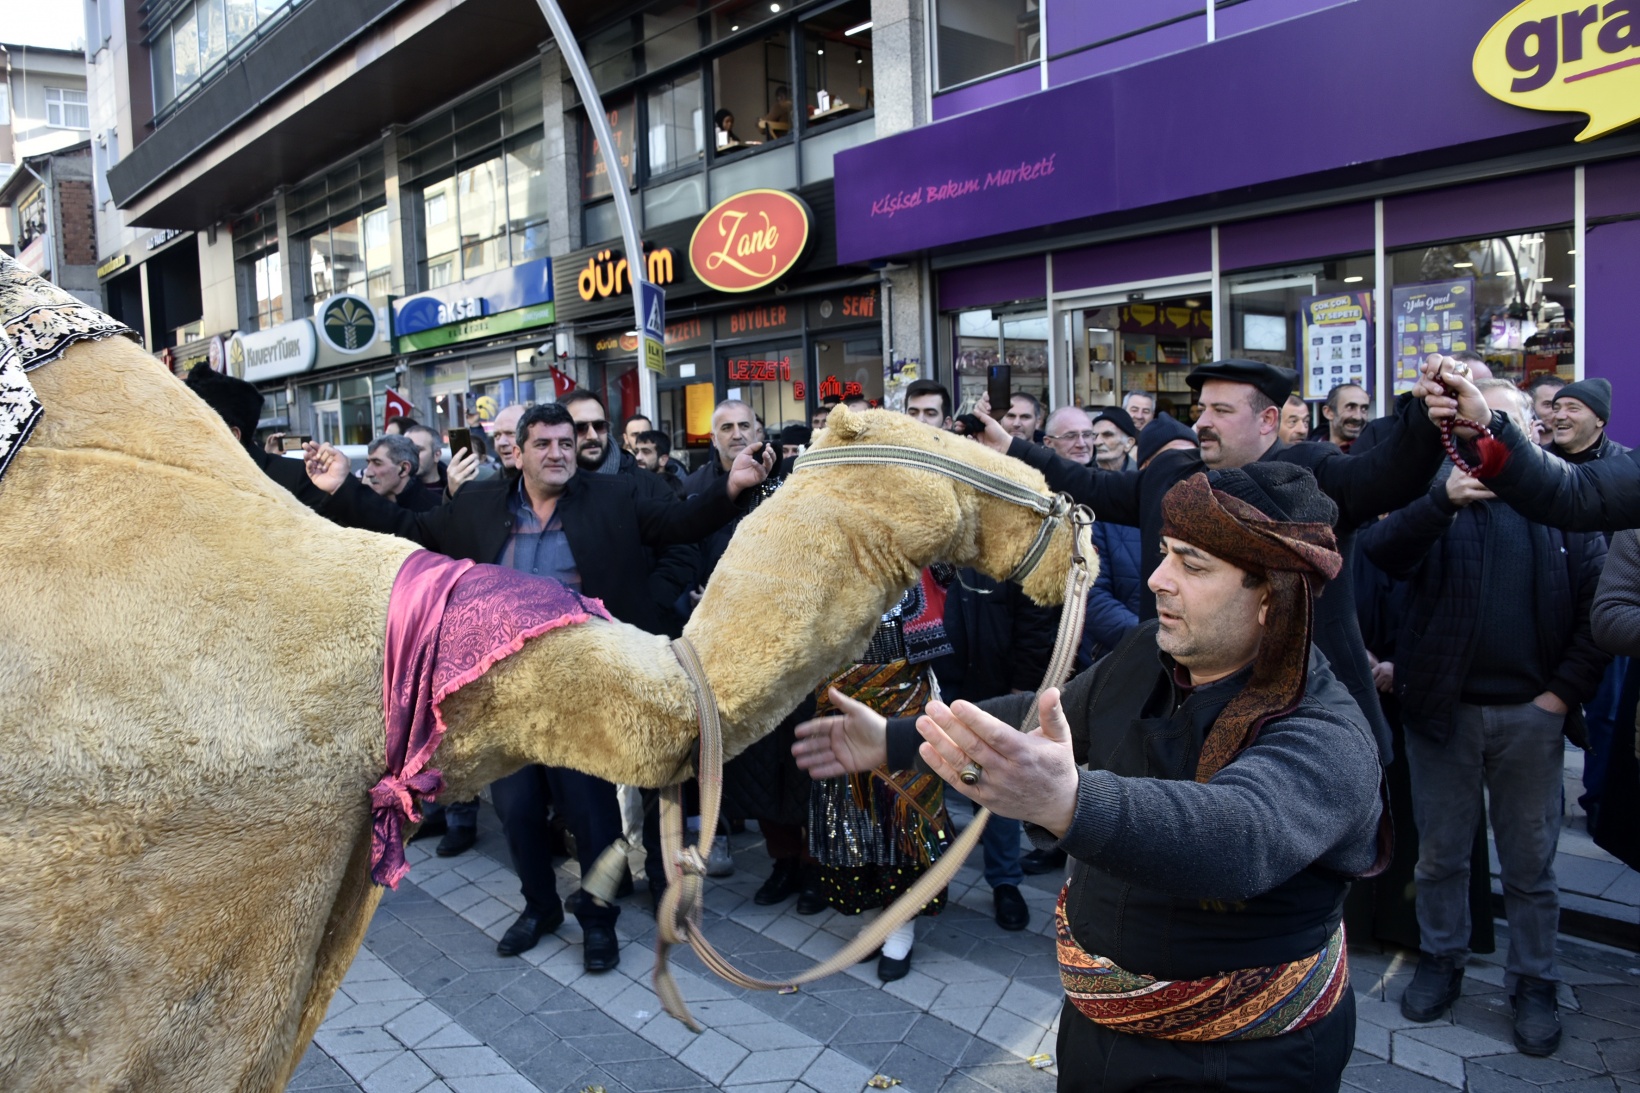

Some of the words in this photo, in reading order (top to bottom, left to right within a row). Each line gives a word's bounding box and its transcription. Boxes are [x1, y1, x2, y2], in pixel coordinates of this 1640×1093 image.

[871, 187, 922, 218] Kişisel
[926, 176, 980, 204] Bakım
[983, 153, 1056, 191] Marketi
[706, 210, 779, 278] Zane
[578, 248, 673, 301] dürm
[438, 297, 476, 325] aksa
[730, 305, 787, 333] BÜYÜLER
[1315, 313, 1326, 321] AT
[1327, 309, 1360, 320] SEPETE
[728, 356, 791, 381] LEZZETİ
[794, 375, 863, 401] BYÜLER
